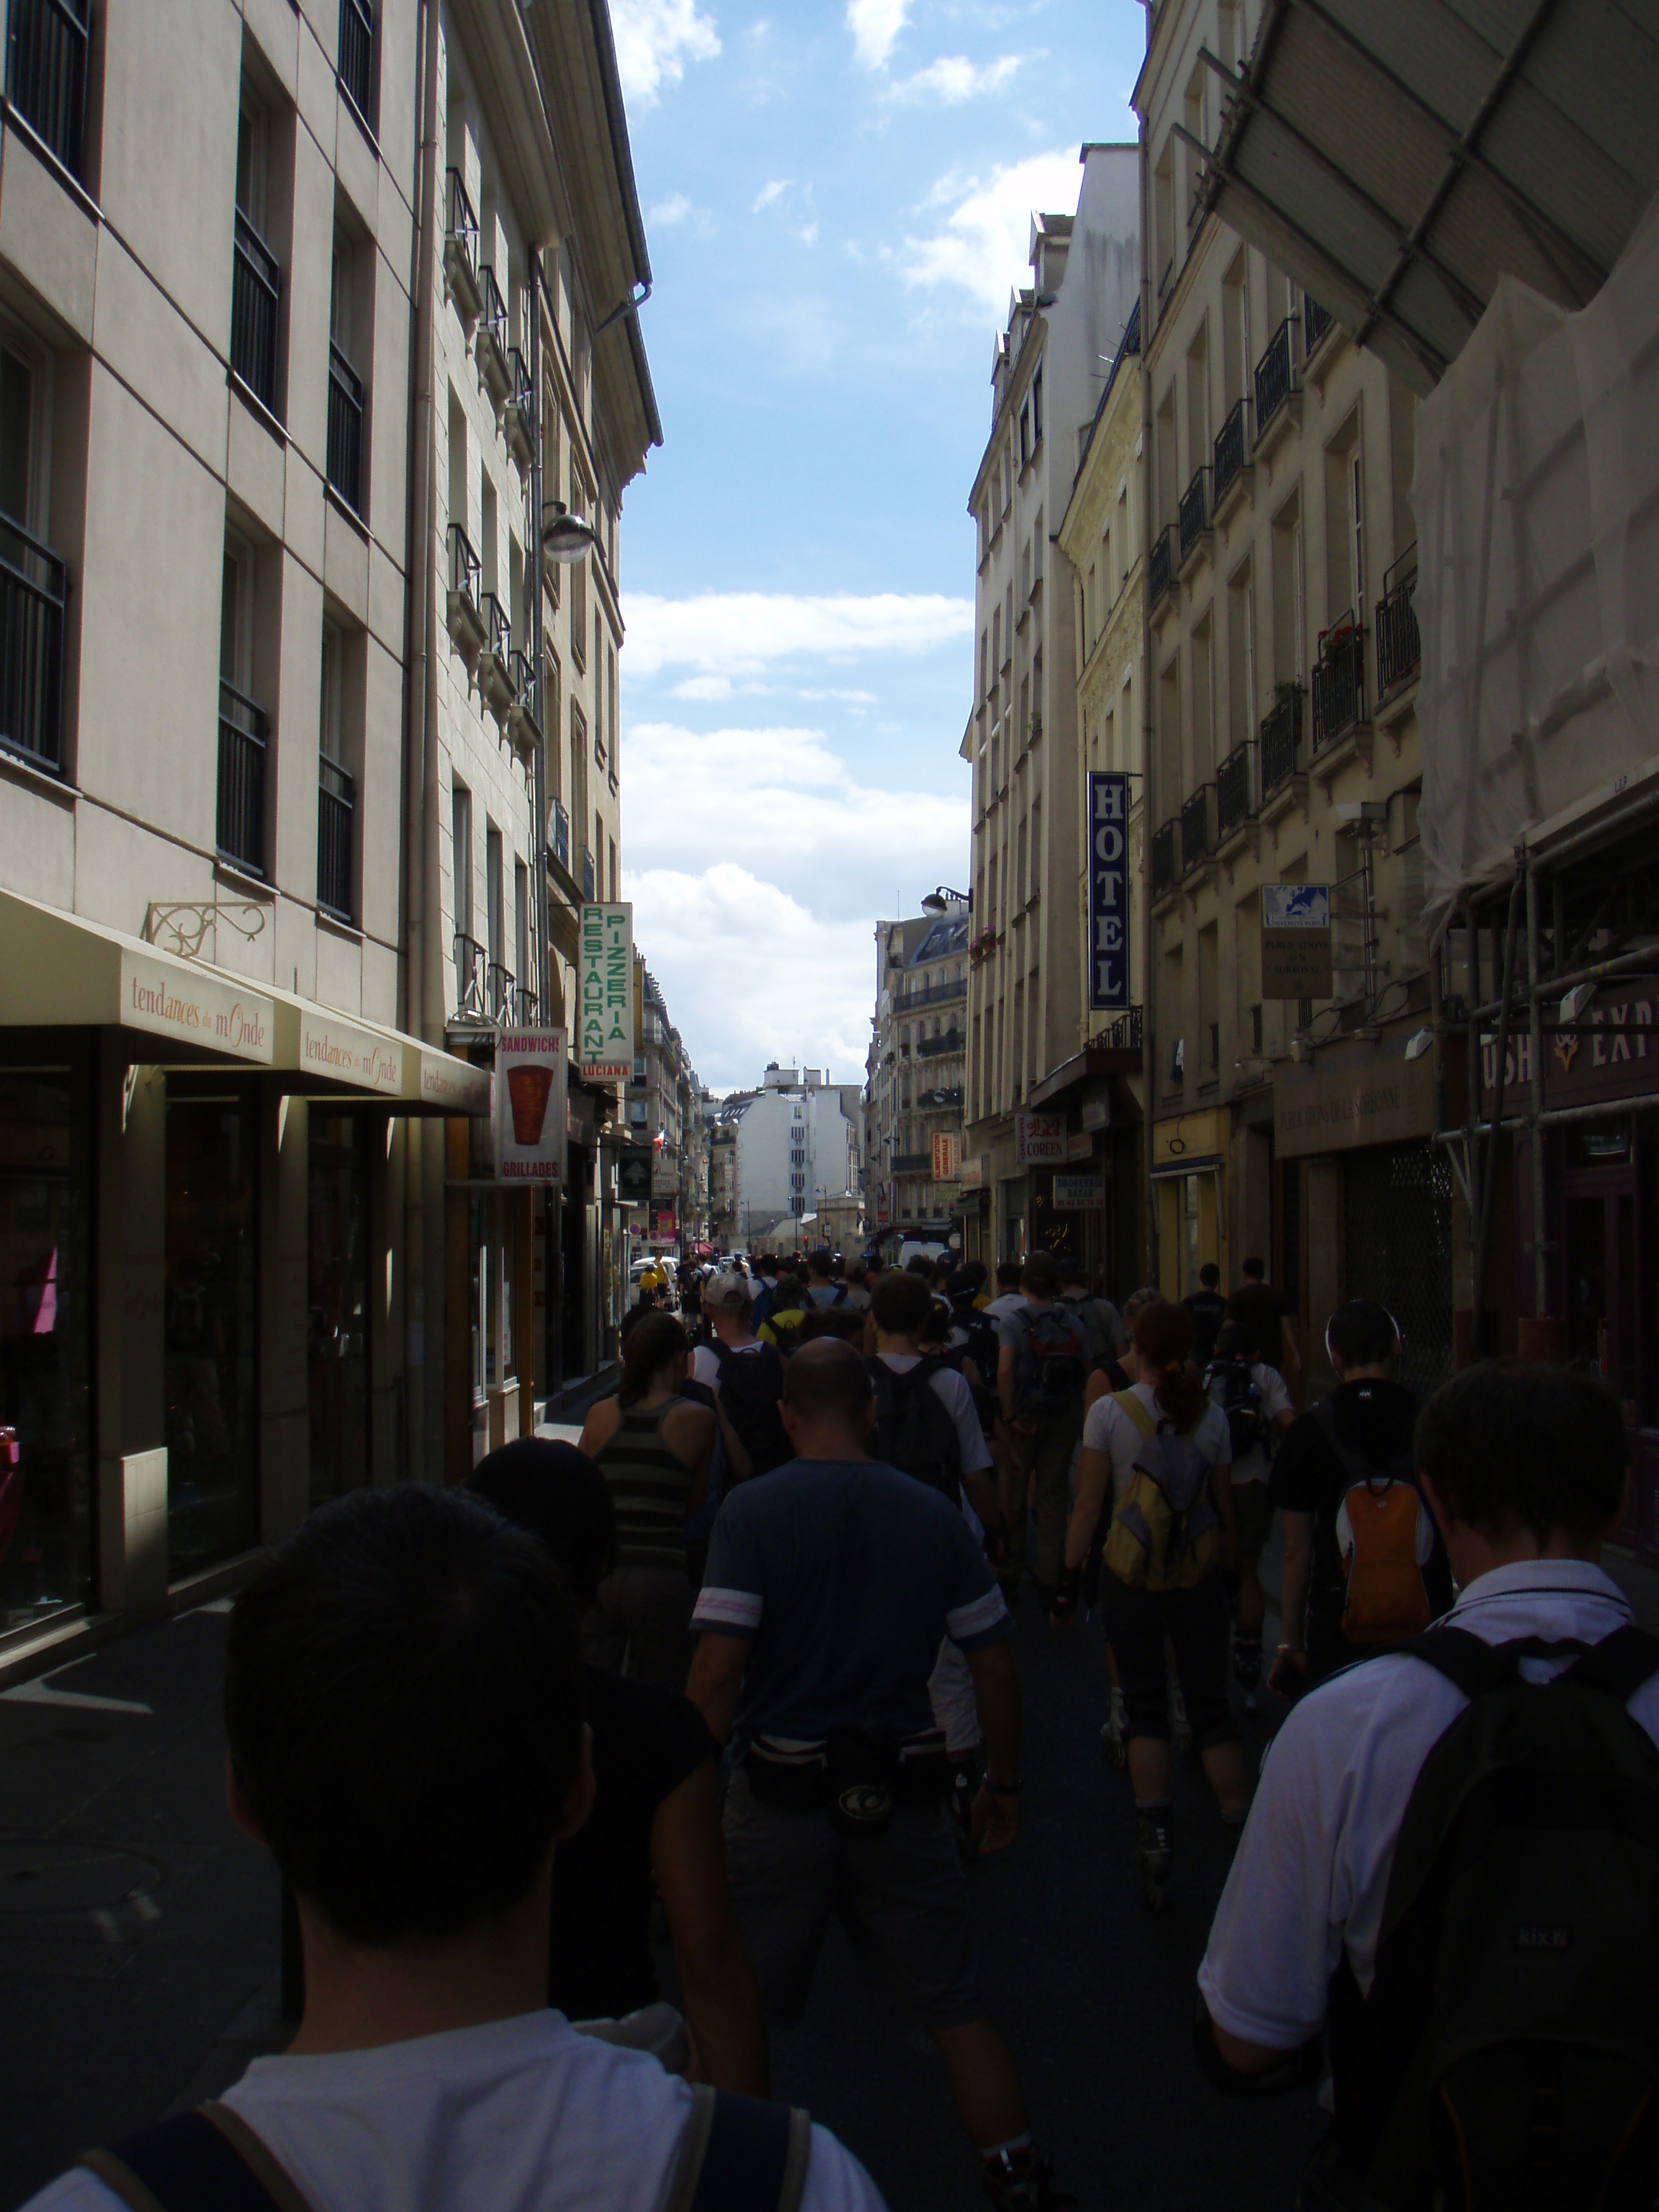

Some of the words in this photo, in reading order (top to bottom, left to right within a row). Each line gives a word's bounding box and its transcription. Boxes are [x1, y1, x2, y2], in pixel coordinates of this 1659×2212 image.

[1094, 783, 1124, 996] HOTEL
[583, 907, 604, 1064] RESTAURANT
[606, 915, 626, 1040] PIZZERIA
[132, 977, 200, 1028] tendances
[305, 1032, 352, 1069] tendances
[1592, 1000, 1659, 1066] EXP
[583, 1066, 629, 1076] LUCIANA
[1027, 1142, 1062, 1156] COREEN
[503, 1161, 558, 1178] GRILLADES
[1058, 1179, 1103, 1188] DROGUERIE
[1067, 1189, 1094, 1198] BAZAR
